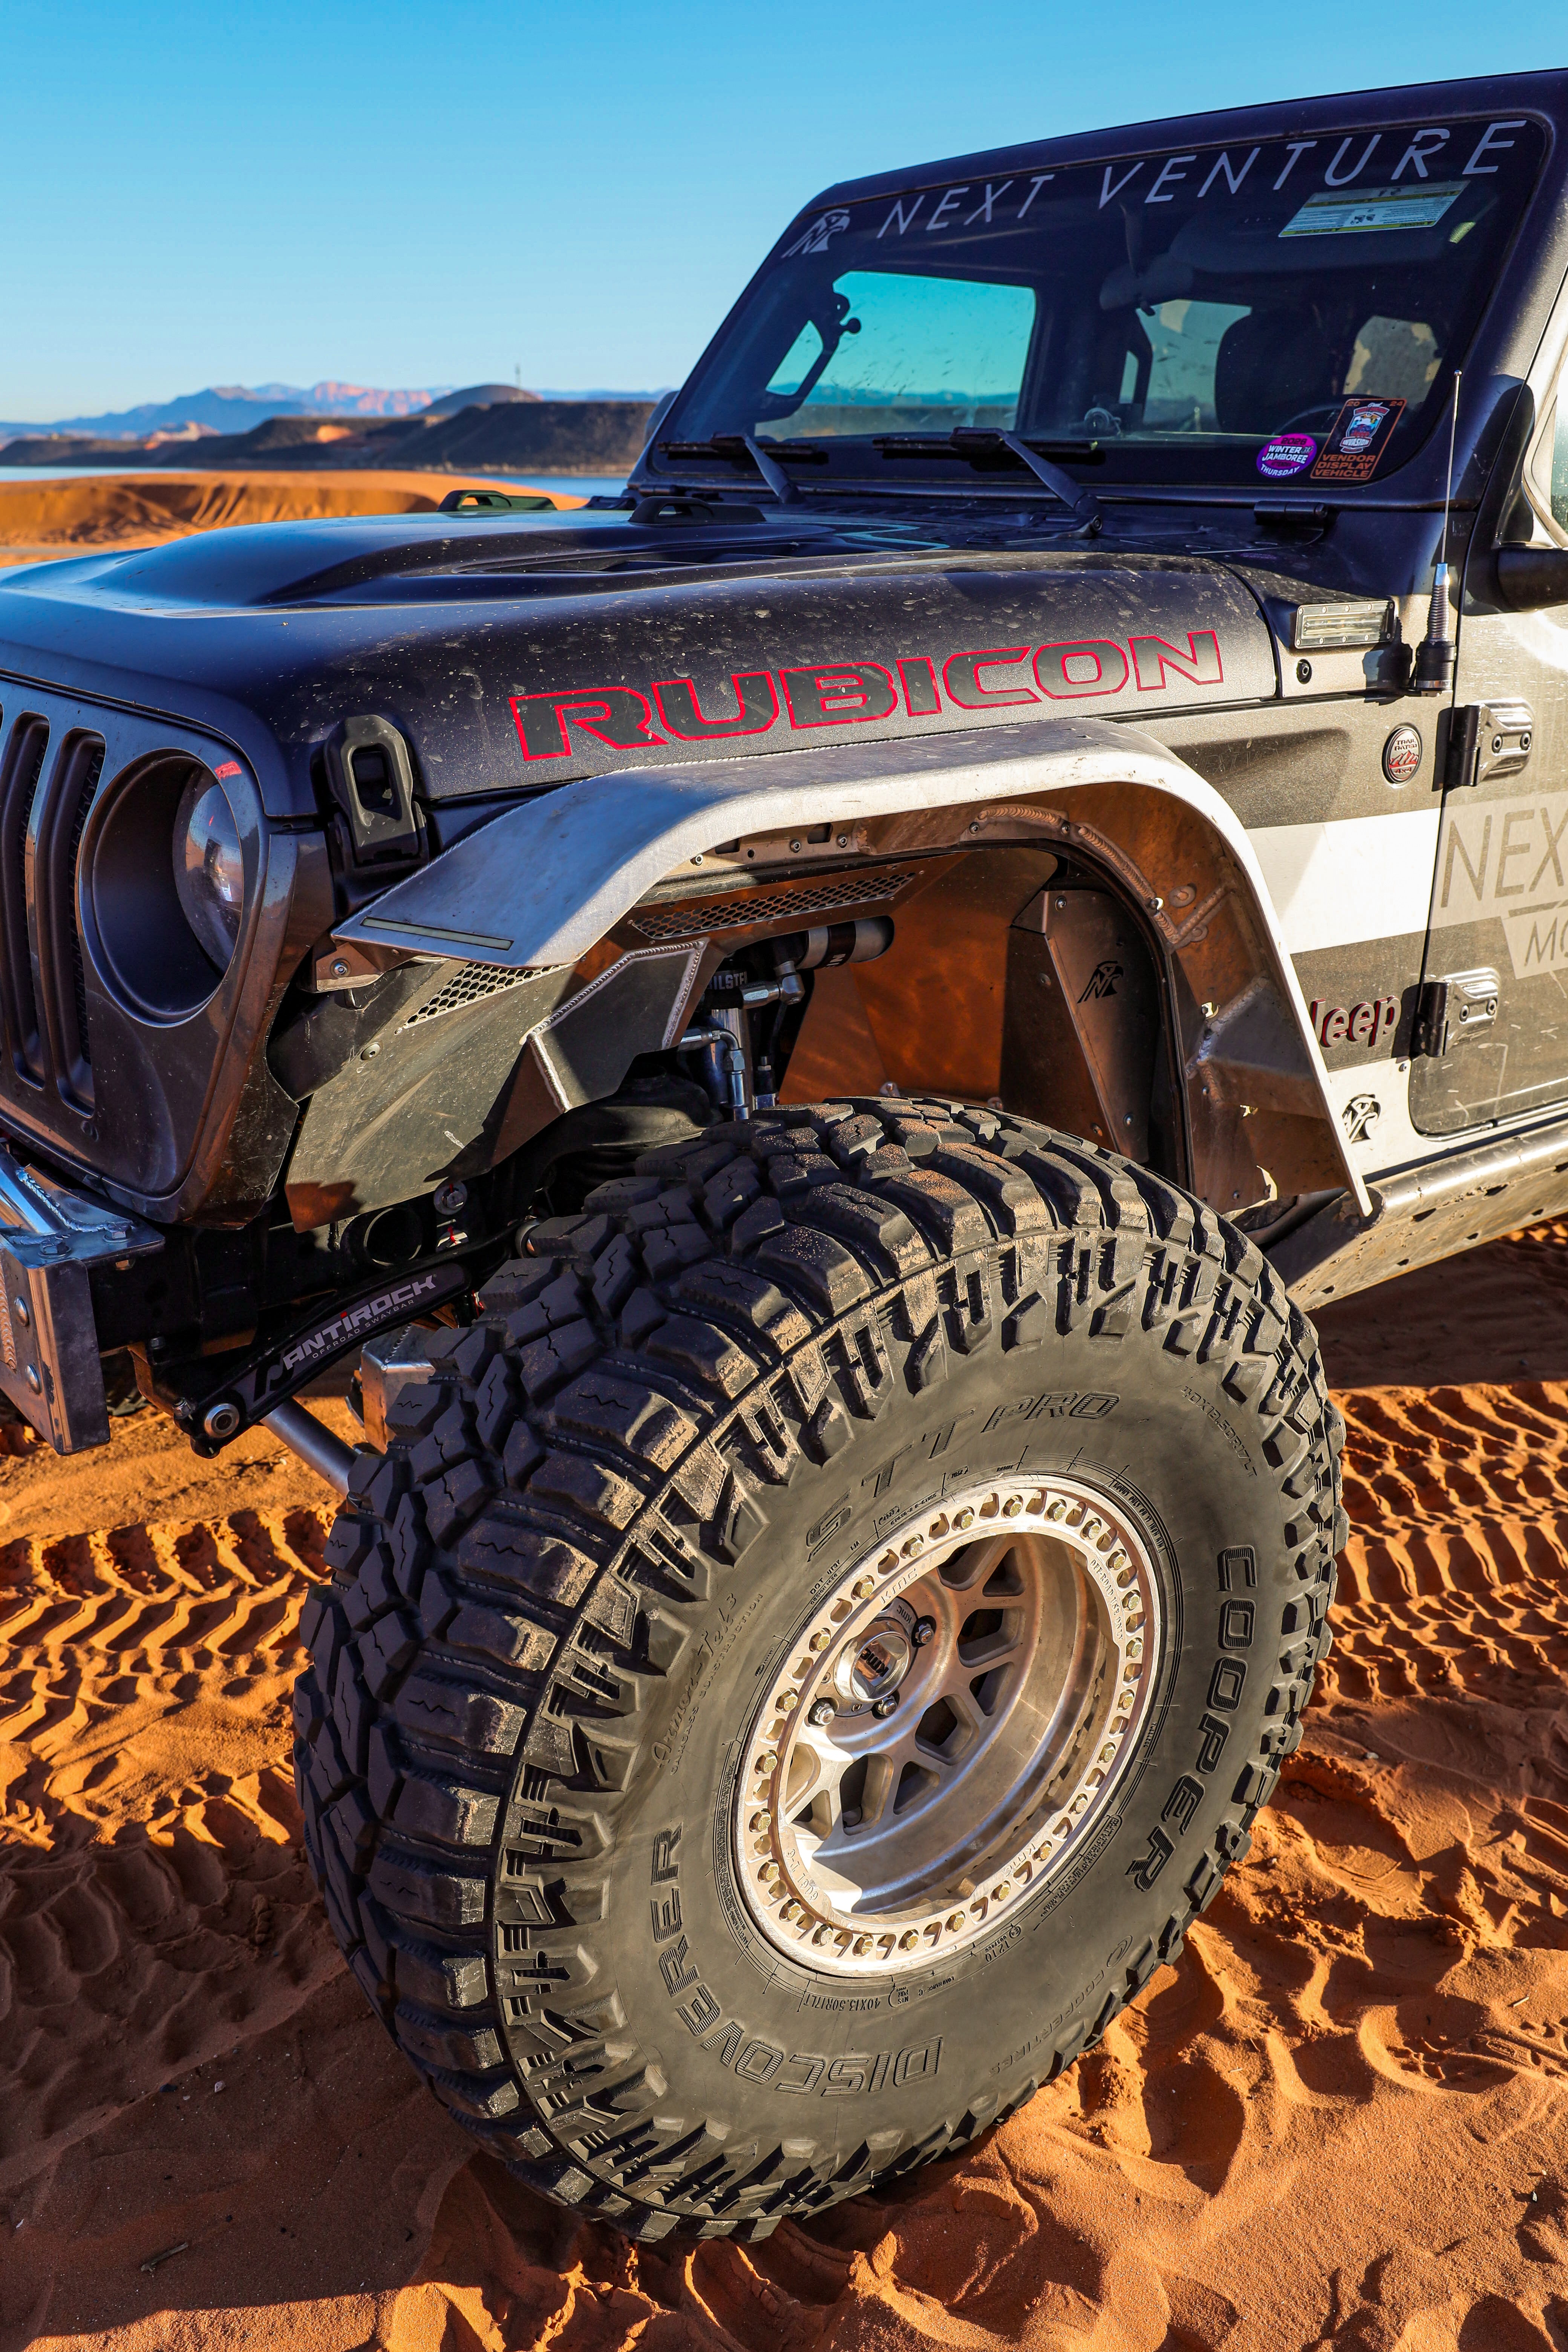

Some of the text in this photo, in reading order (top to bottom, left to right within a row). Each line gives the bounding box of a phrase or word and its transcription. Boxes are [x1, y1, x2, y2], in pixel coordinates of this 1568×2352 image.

[876, 174, 1055, 239] NEXT
[1098, 120, 1527, 210] VENTURE
[1261, 463, 1300, 476] THURSDAY
[1262, 453, 1308, 464] JAMBOREE
[1268, 445, 1302, 453] WINTER
[1315, 469, 1369, 477] VEHICLE
[509, 630, 1225, 761] RUBICON
[312, 1299, 414, 1358] OFFROAD SWAYBAR
[806, 1391, 1122, 1563] STT PRO
[1112, 1481, 1131, 1497] MOUNT
[1129, 1495, 1141, 1508] ONLY
[1139, 1508, 1148, 1516] ON
[1148, 1523, 1160, 1536] INCH
[1156, 1536, 1165, 1548] RIM
[810, 1577, 824, 1595] DOT
[1090, 1559, 1123, 1640] OFF-ROAD USE ONLY
[699, 1593, 763, 1699] CONSTRUCTION
[1125, 1545, 1257, 1892] COOPER
[651, 1823, 943, 2098] DISCOVERER
[985, 1940, 1010, 1962] 121Q
[803, 1994, 881, 2012] 40X13.50R17LT
